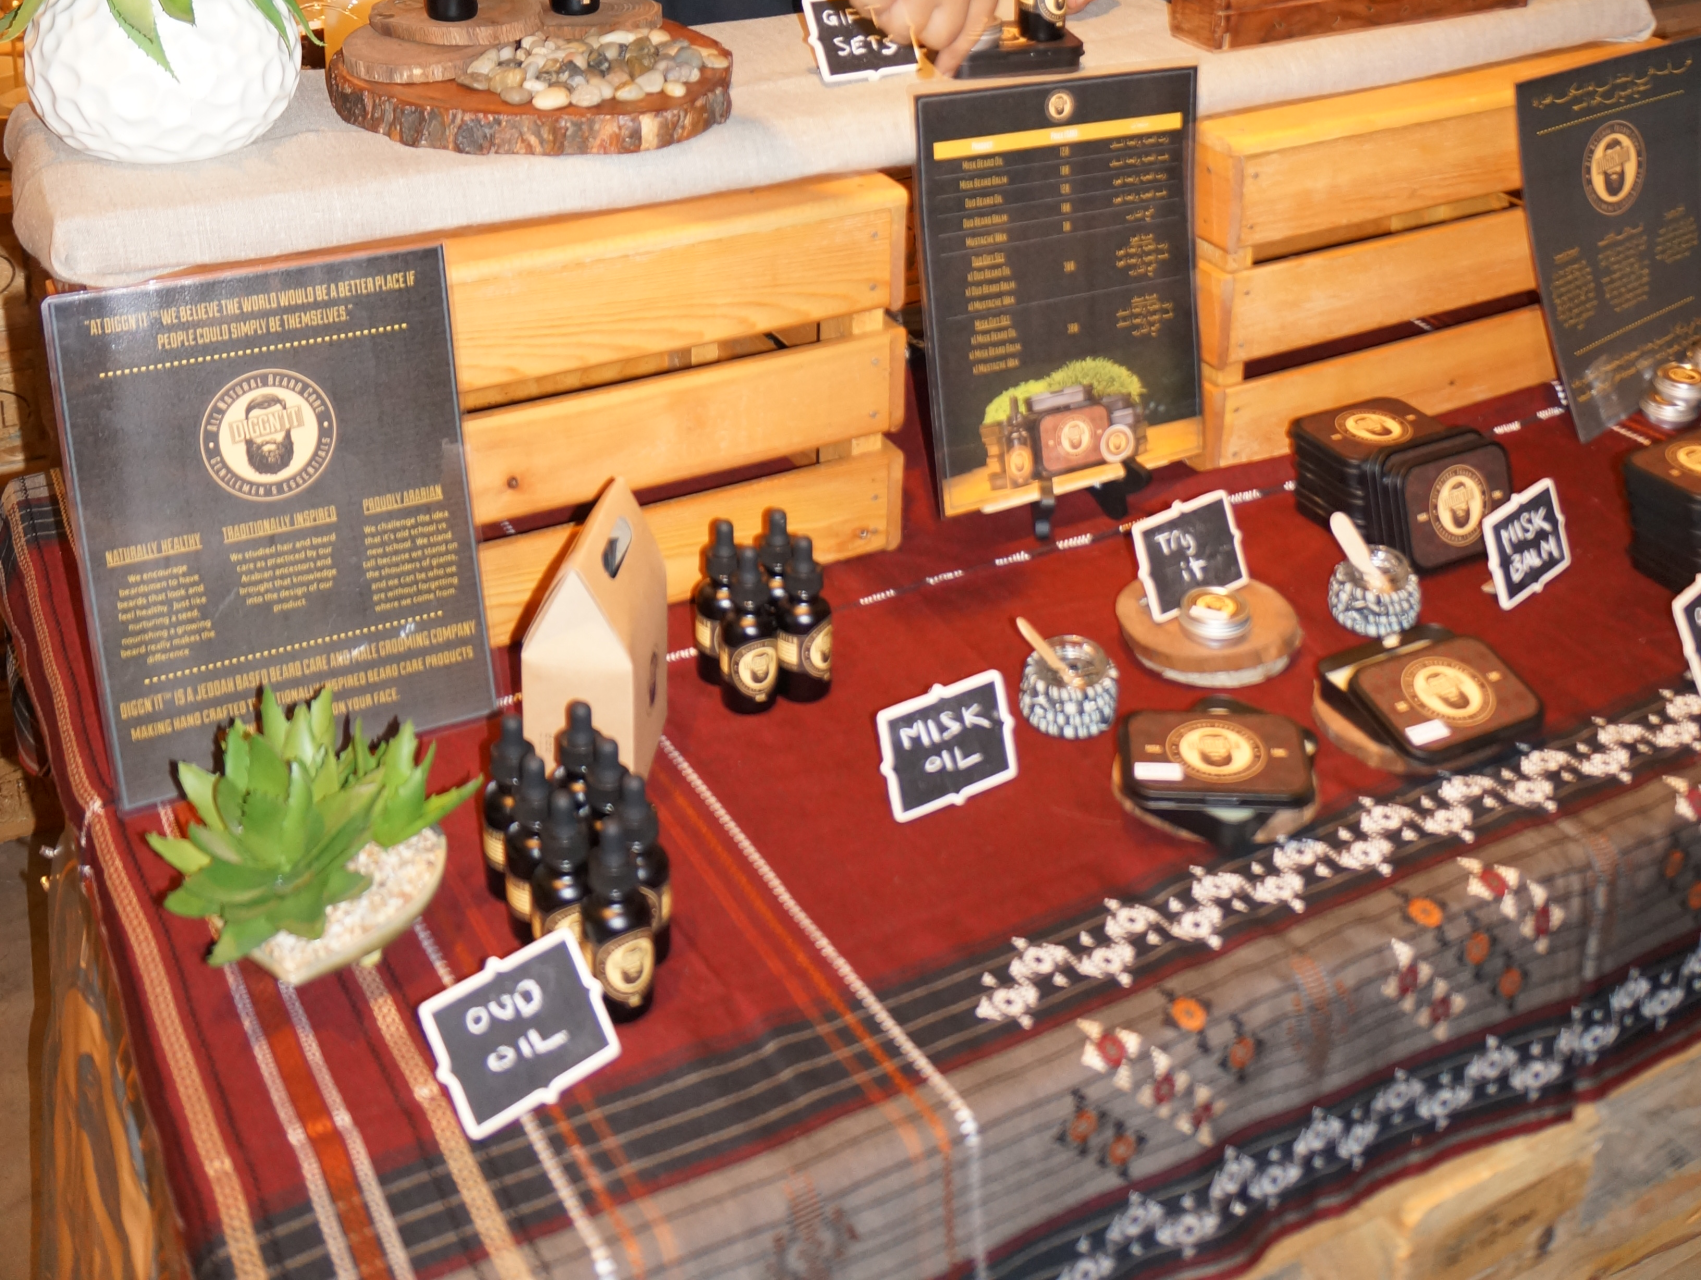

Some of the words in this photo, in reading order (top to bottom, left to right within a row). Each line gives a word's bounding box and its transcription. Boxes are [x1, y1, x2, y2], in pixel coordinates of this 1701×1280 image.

[833, 34, 898, 57] SETS
[160, 307, 178, 325] WE
[179, 301, 220, 323] BELIEVE
[221, 298, 240, 316] THE
[241, 292, 278, 313] WORLD
[278, 287, 314, 307] WOULD
[315, 285, 328, 301] BE
[330, 283, 338, 299] A
[338, 277, 374, 298] BETTER
[375, 273, 405, 291] PLACE
[406, 271, 415, 286] IF
[157, 329, 195, 350] PEOPLE
[196, 324, 229, 344] COULD
[230, 319, 266, 339] SIMPLY
[269, 316, 282, 333] BE
[363, 494, 404, 514] PROUDLY
[402, 485, 443, 506] ARABIAN
[222, 516, 292, 542] TRADITIONALLY
[293, 506, 337, 529] INSPIRED
[363, 526, 376, 534] We
[377, 518, 416, 531] challenge
[416, 514, 431, 523] the
[432, 511, 449, 520] idea
[1500, 506, 1553, 555] MISK
[105, 542, 159, 566] NATURALLY
[160, 533, 202, 555] HEALTHY
[230, 553, 243, 562] We
[244, 546, 276, 559] studied
[276, 543, 293, 552] hair
[295, 538, 311, 549] and
[311, 533, 336, 545] beard
[1154, 529, 1197, 556] Try
[1509, 534, 1561, 584] BALM
[237, 562, 255, 573] care
[256, 561, 265, 569] as
[267, 551, 306, 566] practiced
[305, 549, 317, 558] by
[318, 546, 332, 556] our
[241, 571, 273, 583] Arabian
[275, 562, 315, 576] ancestors
[316, 557, 332, 568] and
[1180, 556, 1207, 581] it
[174, 689, 186, 706] IS
[186, 687, 195, 702] A
[196, 678, 235, 701] JEDDAH
[234, 668, 269, 692] BASED
[269, 661, 302, 683] BEARD
[303, 655, 328, 674] CARE
[379, 631, 430, 657] GROOMING
[430, 621, 475, 644] COMPANY
[131, 719, 172, 740] MAKING
[173, 712, 202, 730] HAND
[202, 700, 247, 723] CRAFTED
[366, 664, 399, 683] BEARD
[399, 658, 424, 675] CARE
[425, 646, 473, 667] PRODUCTS
[330, 701, 346, 718] ON
[347, 694, 373, 711] YOUR
[899, 703, 993, 750] MISK
[924, 746, 984, 773] OIL
[465, 978, 543, 1035] OUD
[487, 1028, 570, 1072] OIL
